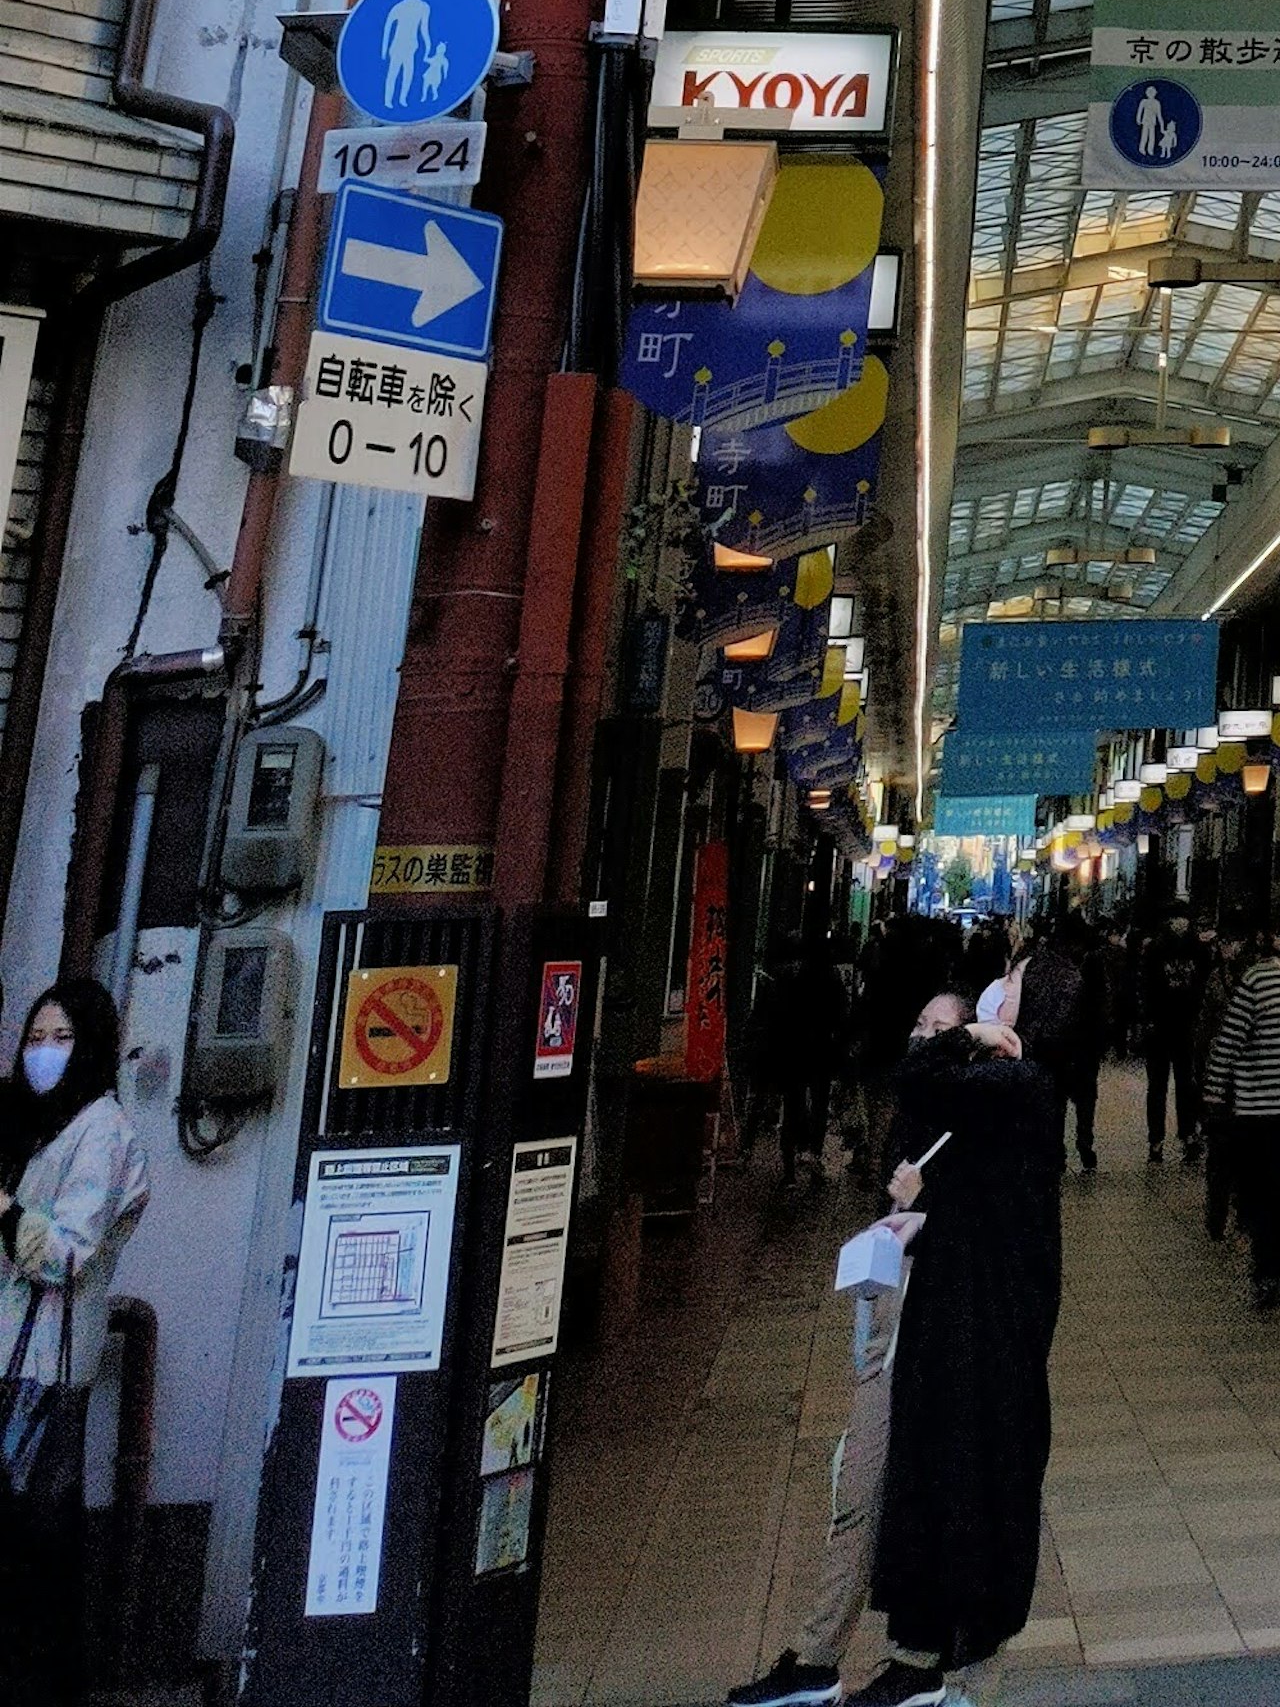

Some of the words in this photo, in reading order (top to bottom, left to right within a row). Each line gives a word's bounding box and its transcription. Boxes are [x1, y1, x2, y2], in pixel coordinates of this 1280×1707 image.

[698, 49, 766, 64] SPORTS
[682, 71, 869, 117] KYOYA
[315, 354, 474, 423] 自転車を除く
